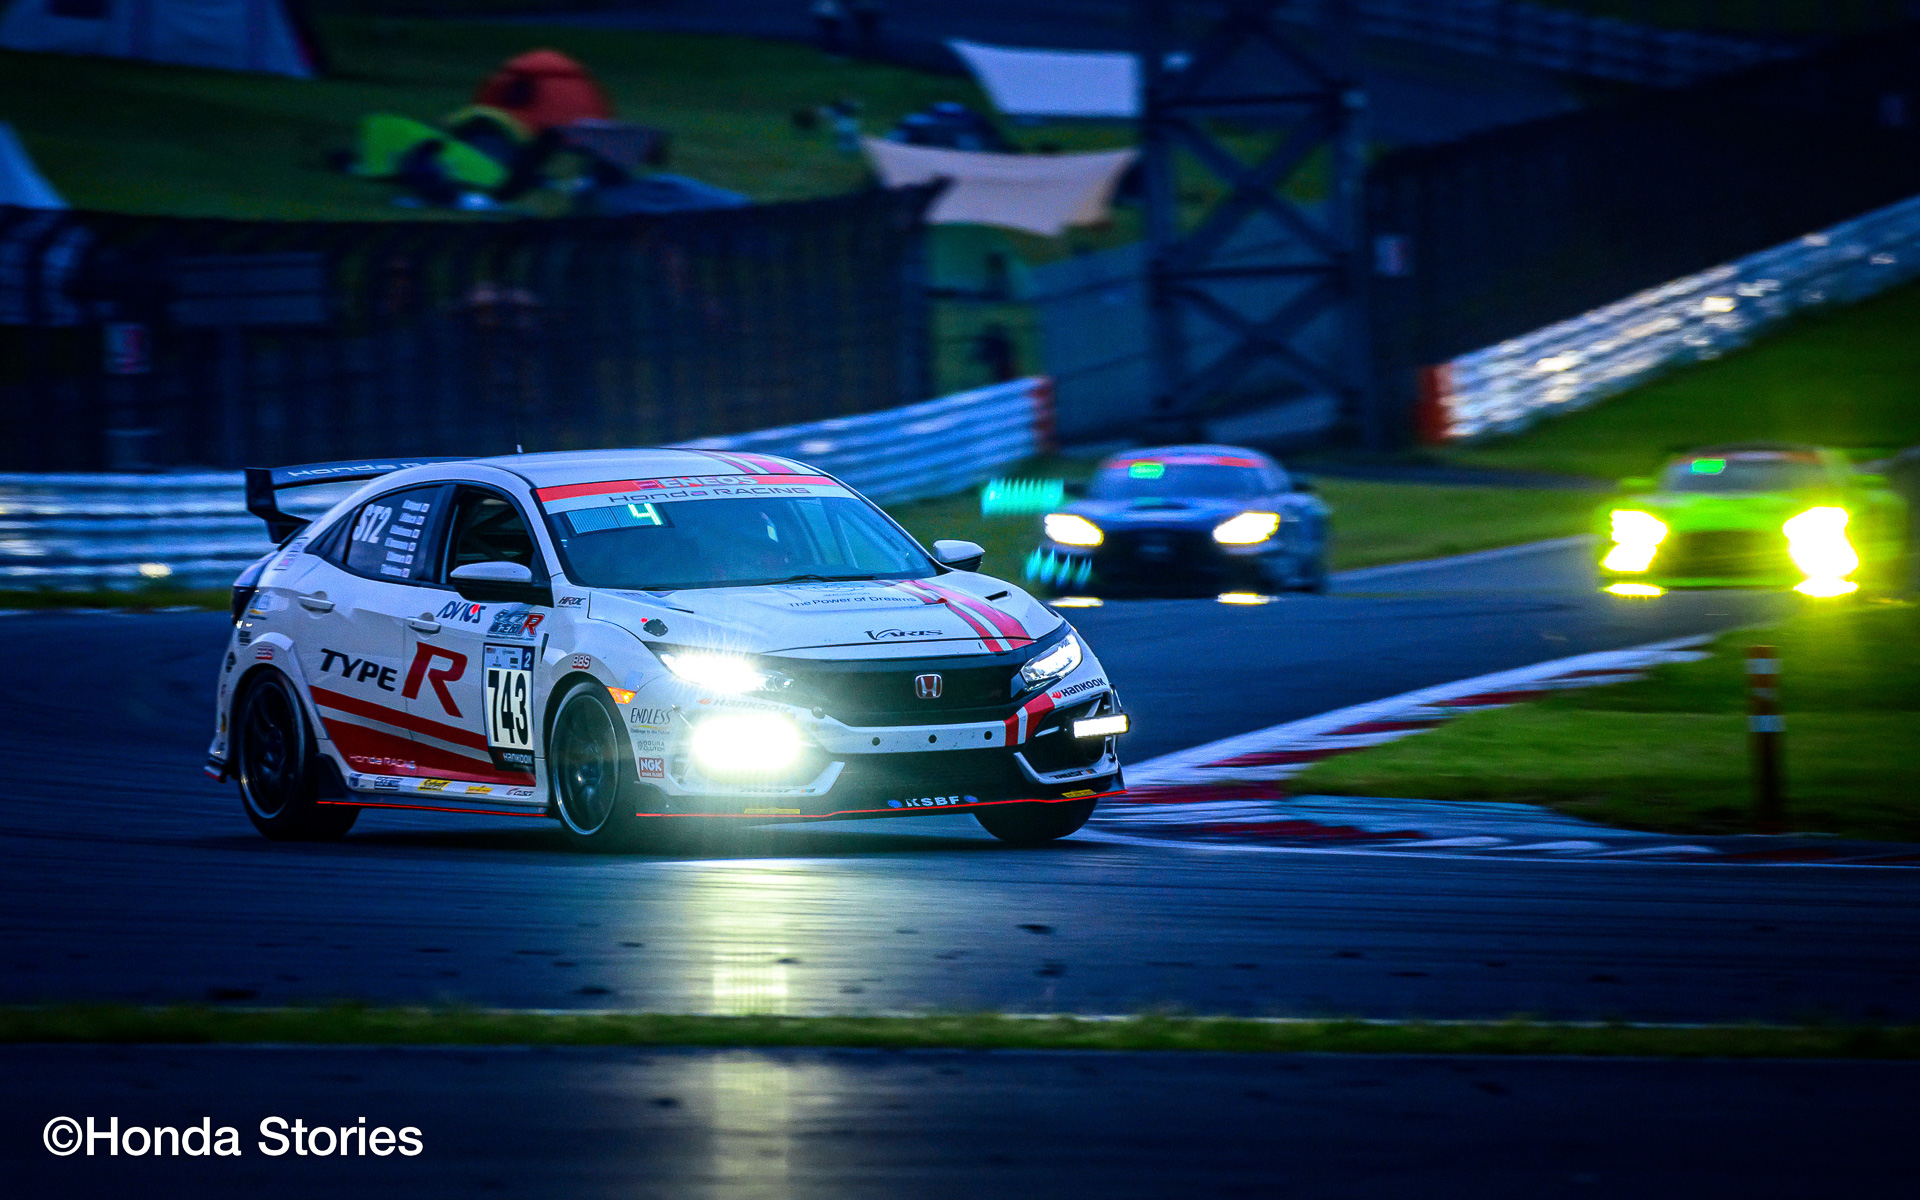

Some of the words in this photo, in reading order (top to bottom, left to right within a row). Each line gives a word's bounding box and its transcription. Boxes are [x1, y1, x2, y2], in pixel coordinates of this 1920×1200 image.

[288, 465, 398, 476] Honda
[660, 477, 759, 488] ENEOS
[608, 490, 707, 503] Honda
[713, 487, 811, 495] RACING
[629, 503, 663, 525] 4
[352, 504, 393, 543] ST2
[864, 629, 943, 640] VARIS
[524, 652, 532, 668] 2
[572, 655, 591, 669] BBS
[320, 648, 398, 692] TYPE
[401, 641, 468, 719] R
[488, 669, 528, 745] 743
[630, 708, 672, 724] ENDLESS
[641, 759, 662, 771] NGK
[905, 796, 959, 807] KSBF
